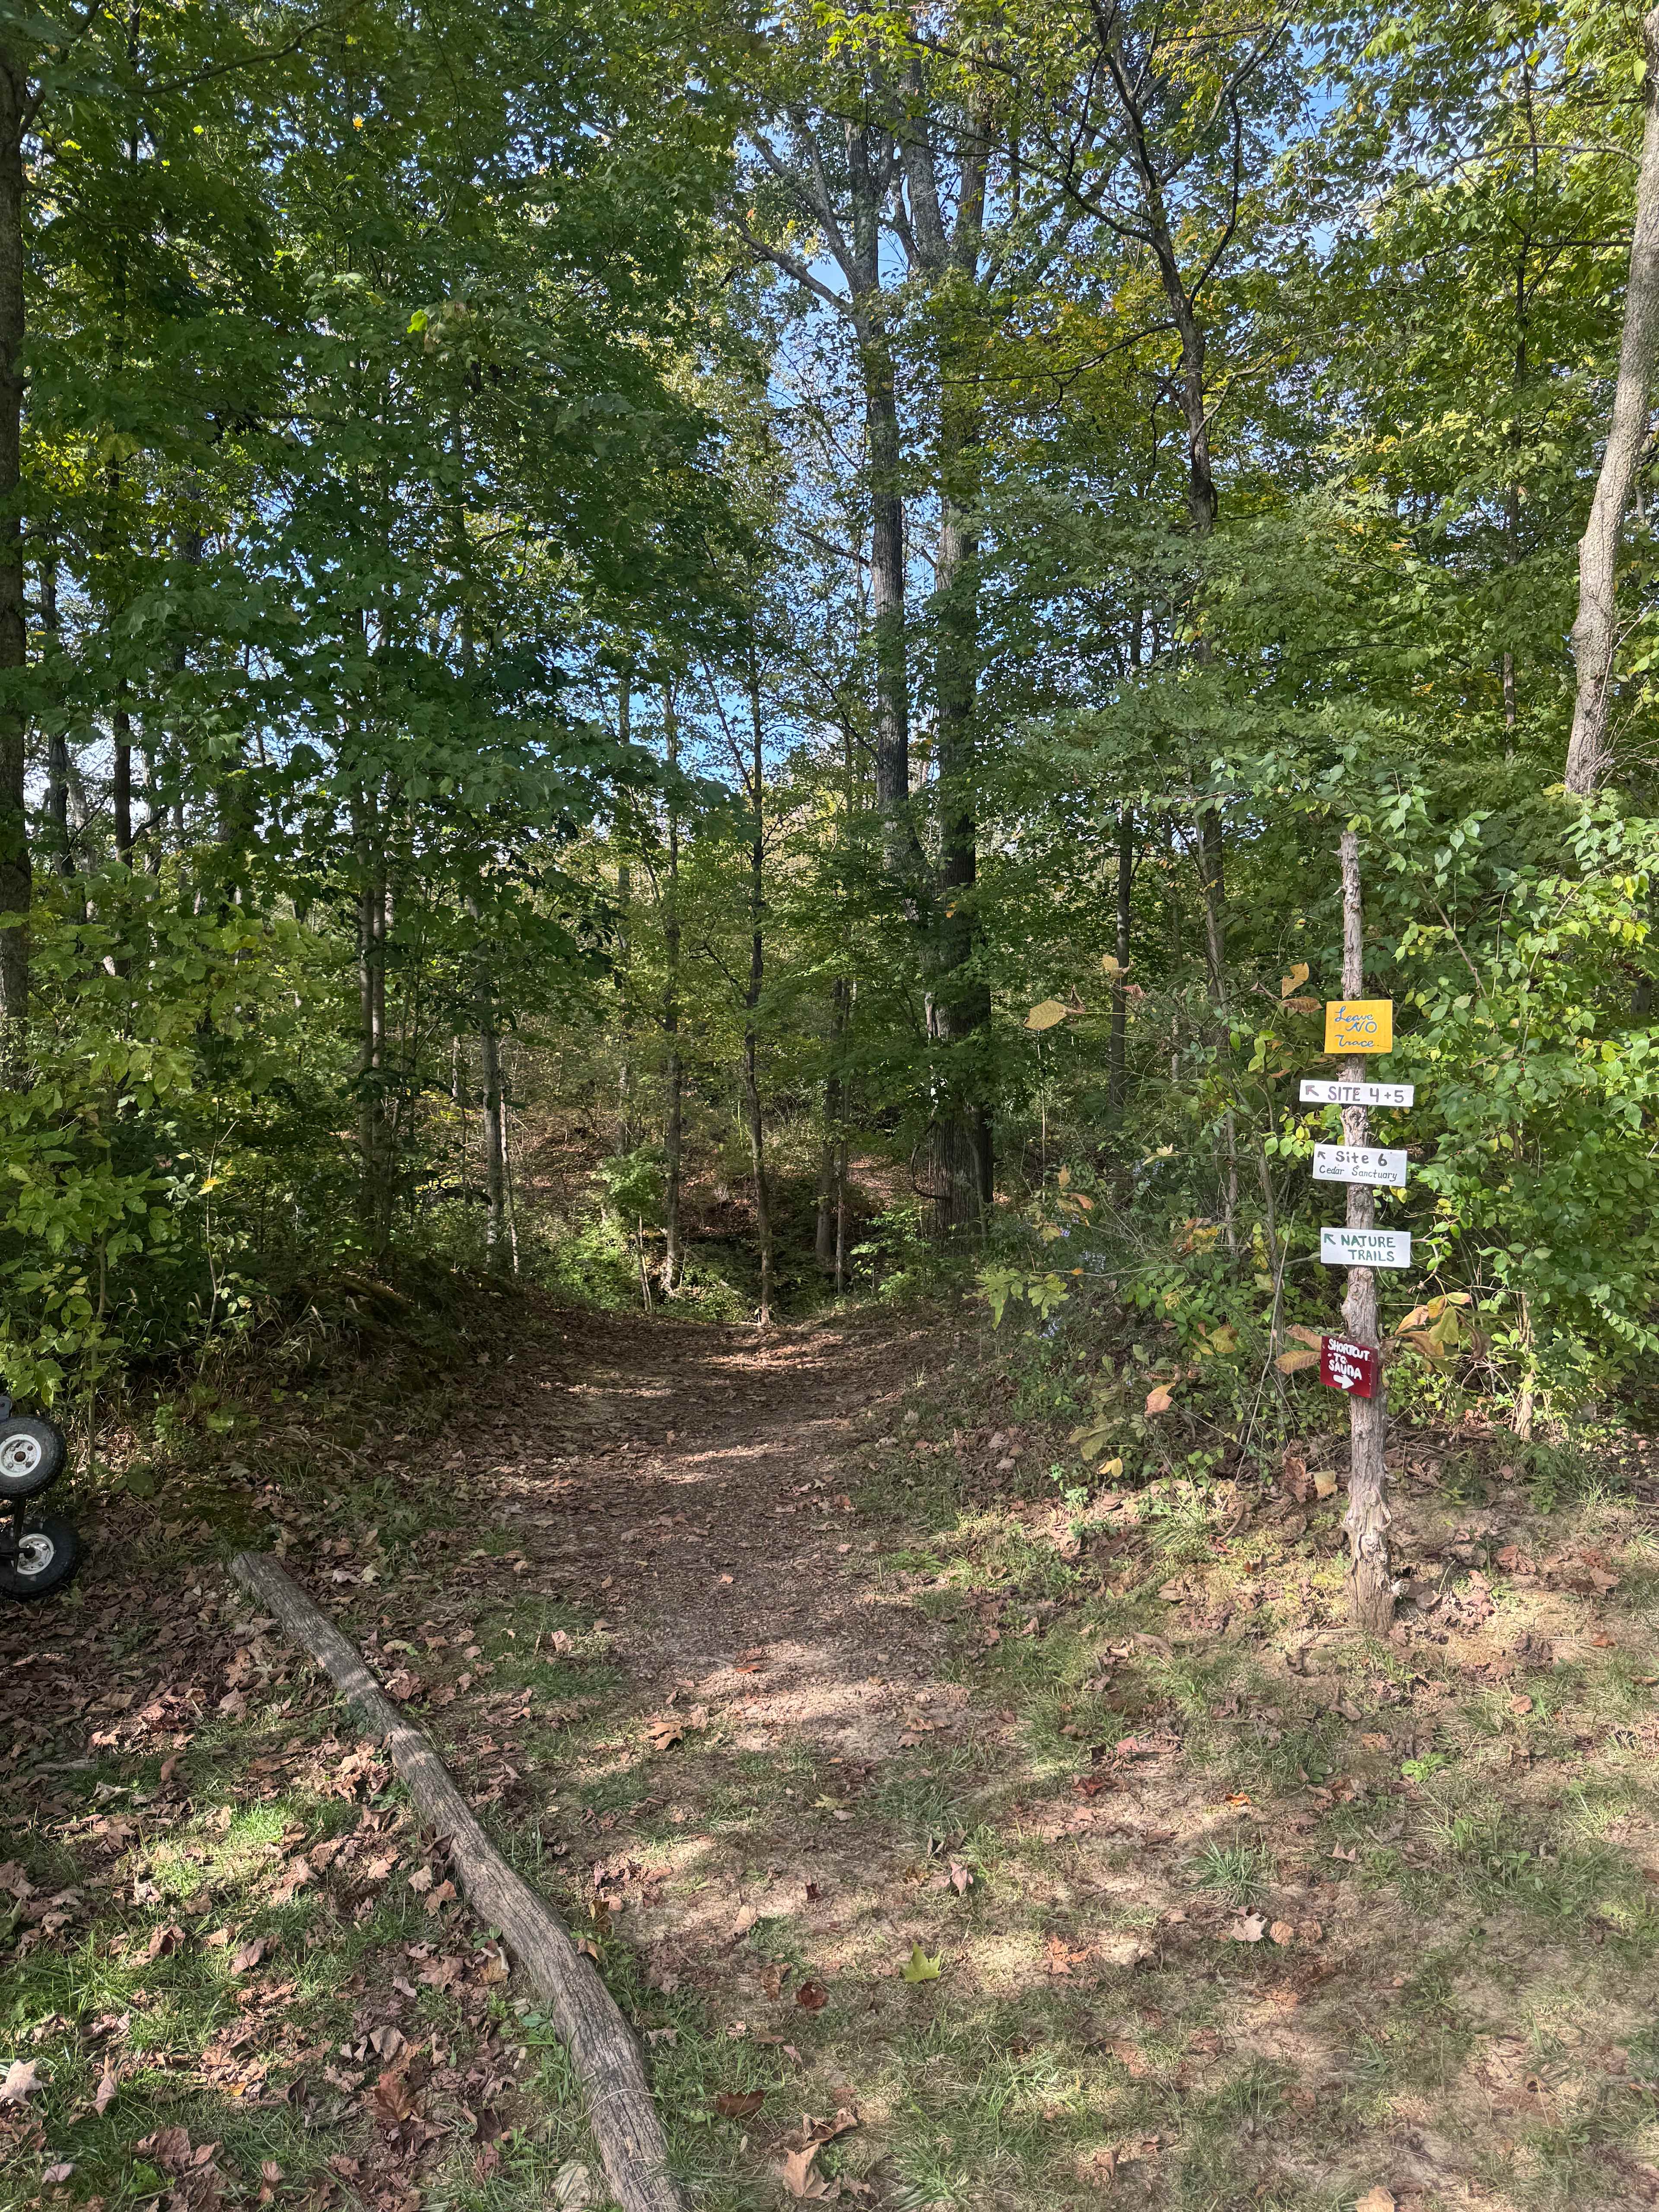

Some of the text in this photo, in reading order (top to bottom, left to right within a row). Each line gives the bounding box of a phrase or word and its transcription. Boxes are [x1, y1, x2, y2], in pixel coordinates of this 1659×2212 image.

[1335, 1006, 1373, 1022] Leave
[1345, 1021, 1377, 1033] NO
[1335, 1035, 1374, 1047] Trace
[1328, 1086, 1360, 1101] SITE
[1335, 1150, 1387, 1166] Site 6
[1319, 1165, 1397, 1182] Cedar Sanctuary
[1341, 1234, 1396, 1247] NATURE
[1348, 1249, 1395, 1262] TRAILS
[1328, 1338, 1370, 1361] SHORTCUT
[1333, 1353, 1348, 1364] TO
